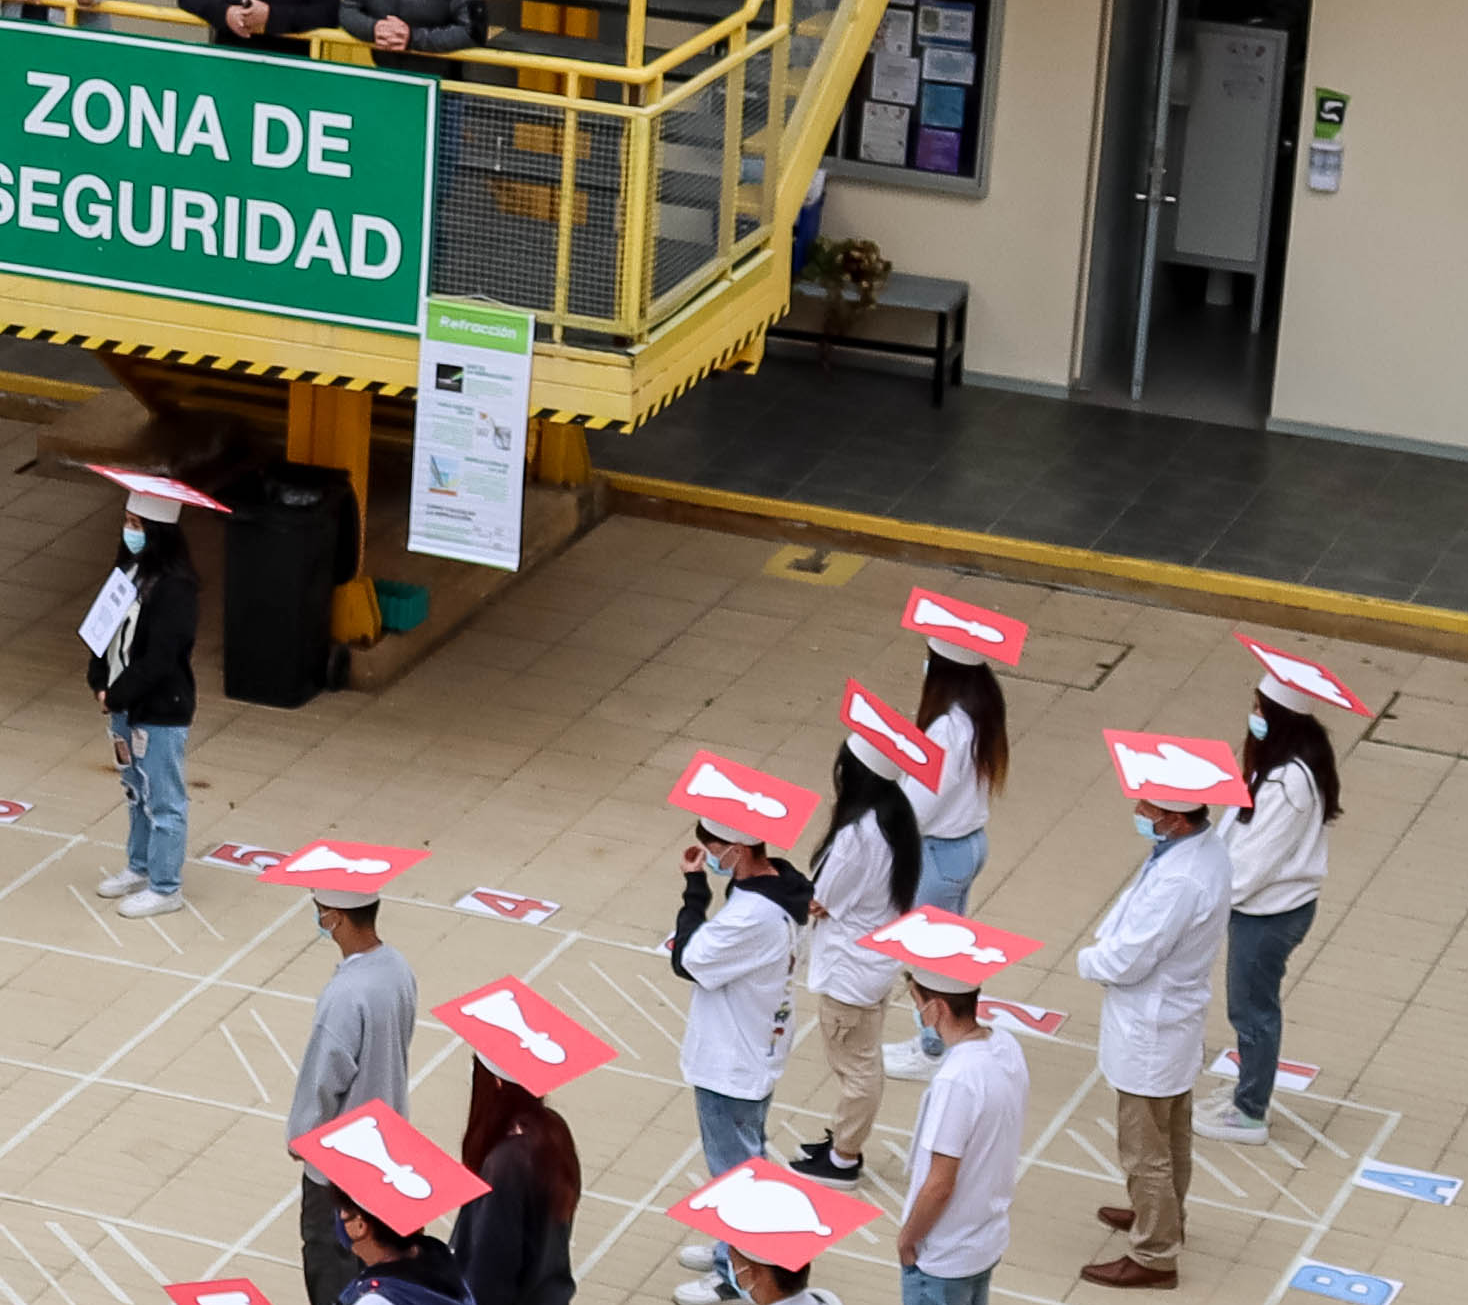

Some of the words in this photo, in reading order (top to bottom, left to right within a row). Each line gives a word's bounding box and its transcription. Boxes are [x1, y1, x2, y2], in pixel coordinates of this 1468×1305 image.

[23, 70, 231, 163] ZONA
[250, 100, 354, 179] DE
[472, 890, 561, 920] 4
[1360, 1166, 1459, 1204] A
